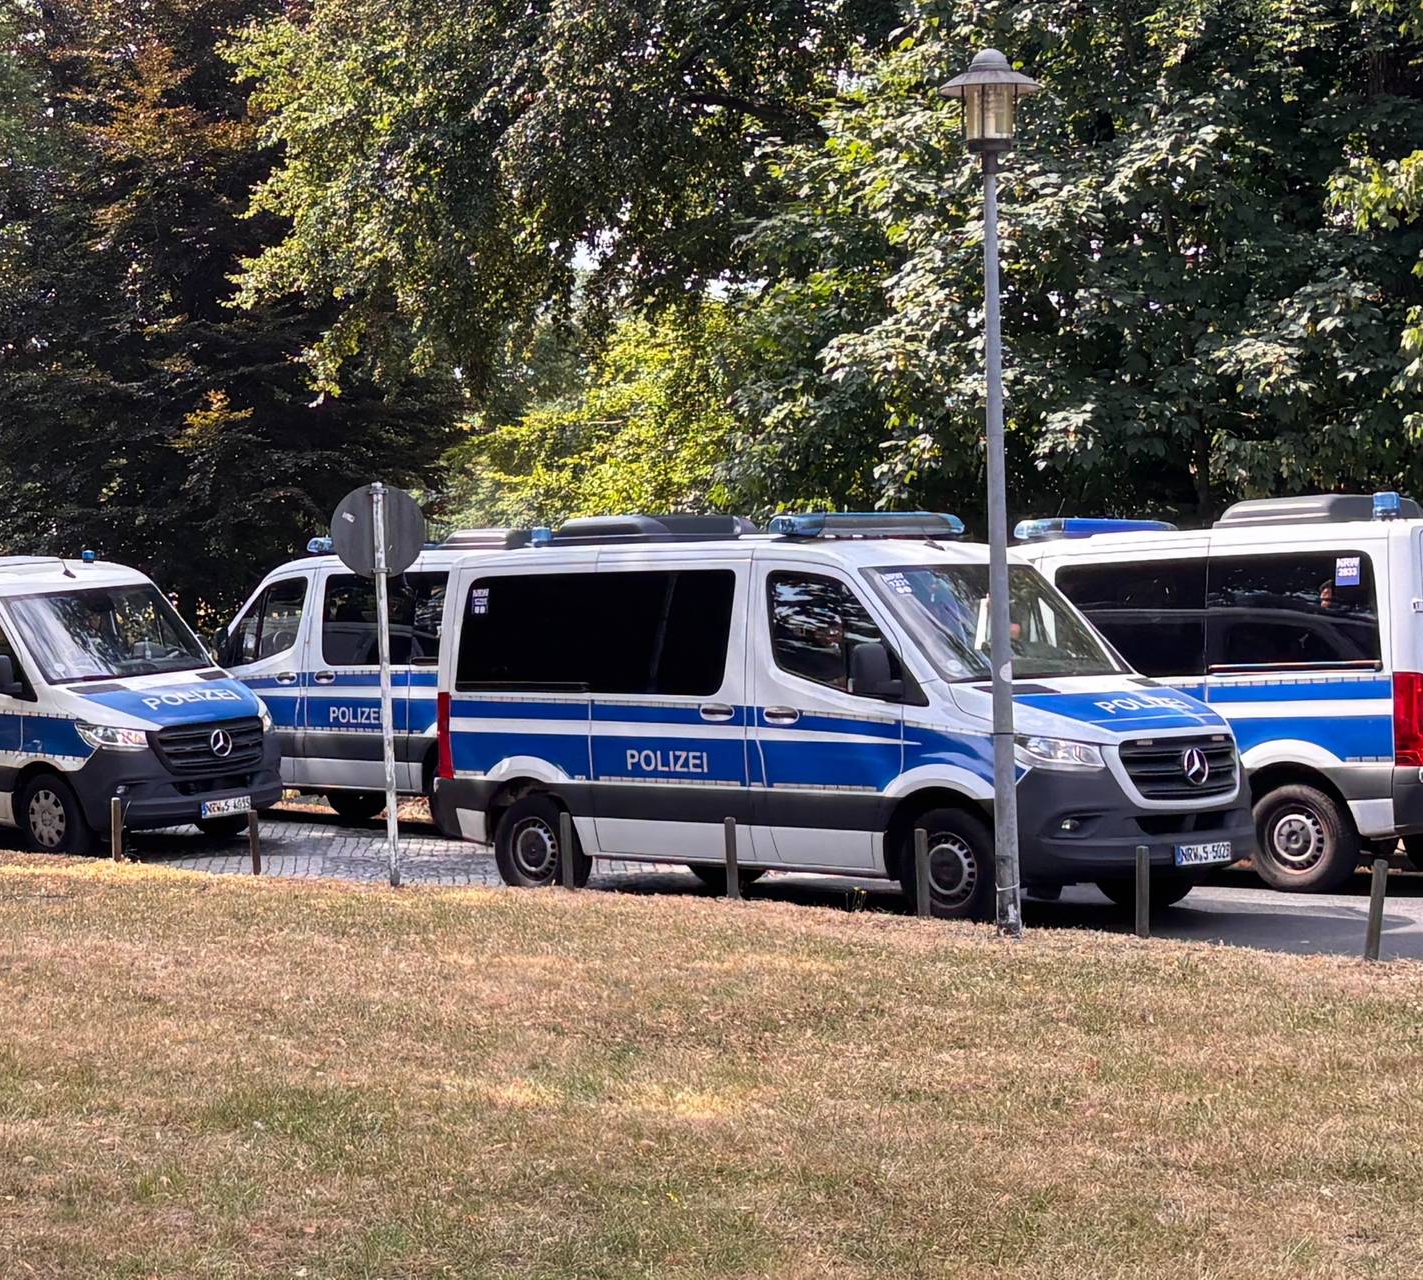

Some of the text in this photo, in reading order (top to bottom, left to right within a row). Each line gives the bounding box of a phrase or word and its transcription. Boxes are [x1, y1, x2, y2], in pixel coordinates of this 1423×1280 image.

[142, 688, 242, 710] POLIZEI
[1093, 697, 1194, 714] POLIZEI
[626, 749, 709, 773] POLIZEI
